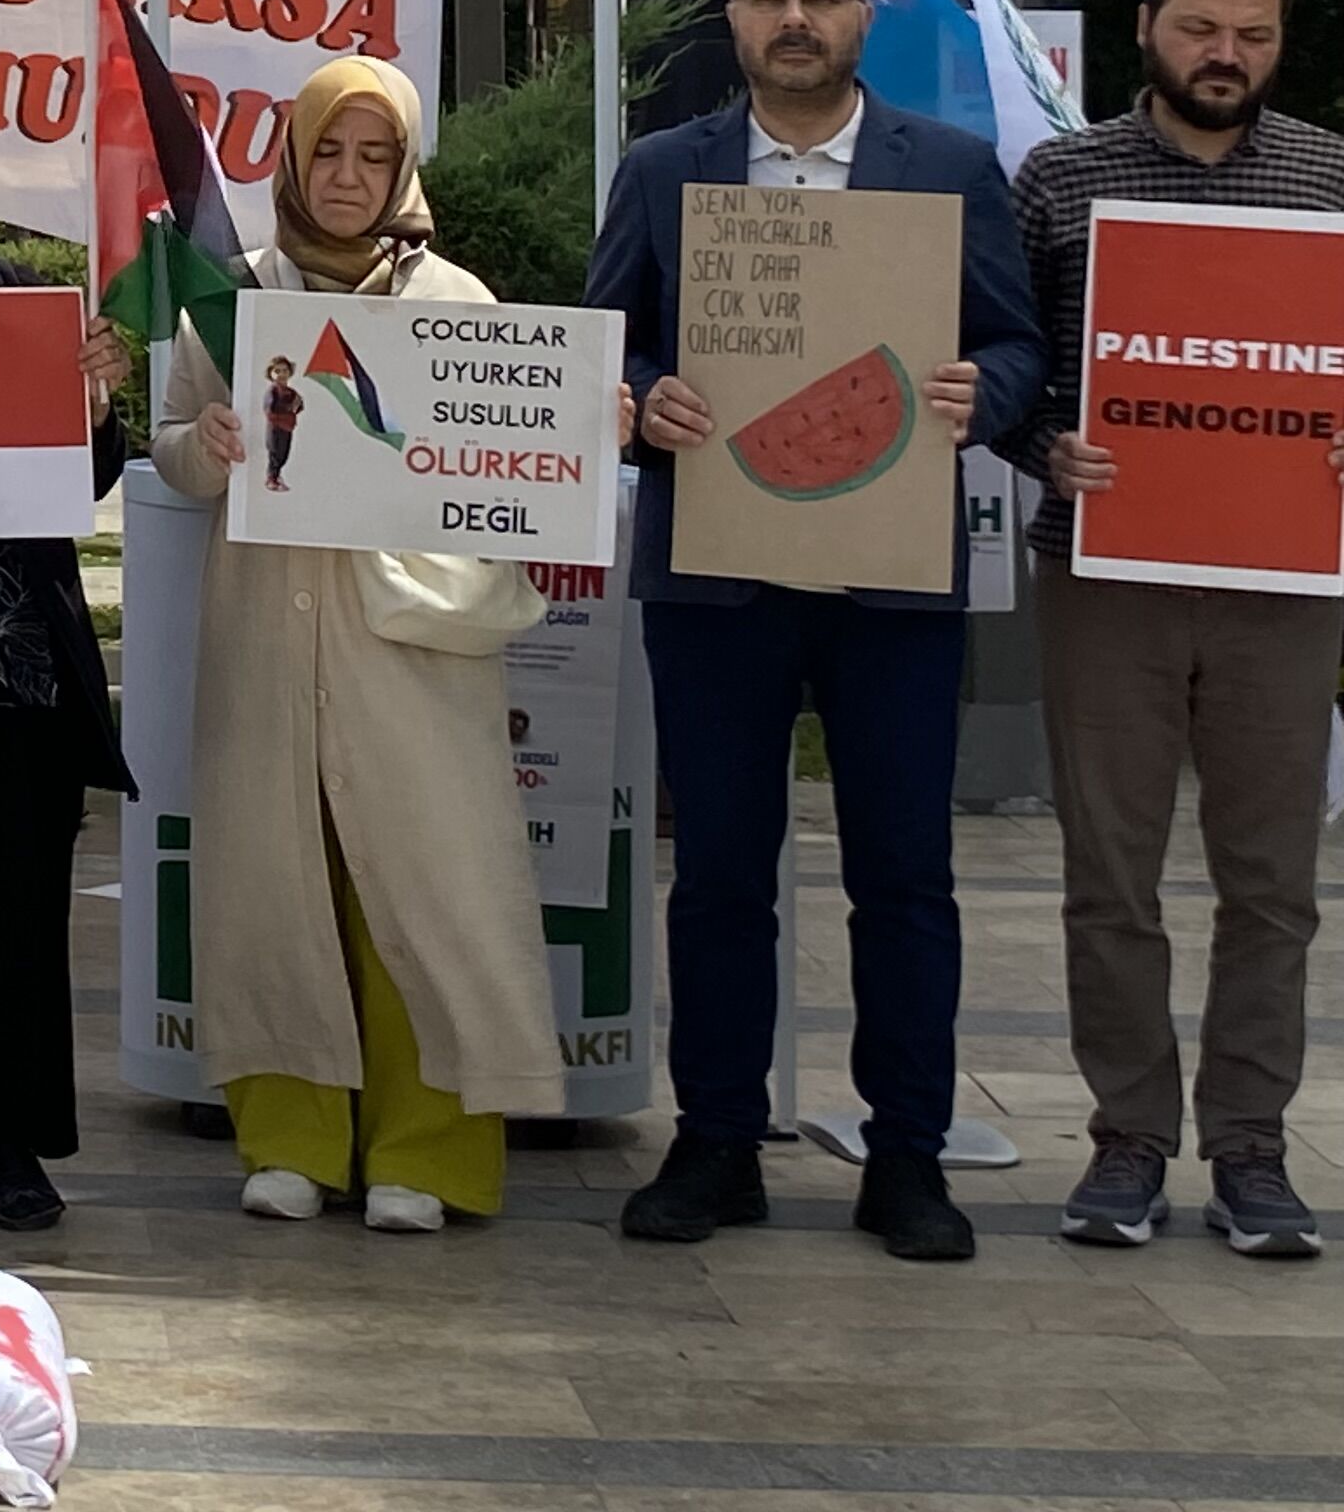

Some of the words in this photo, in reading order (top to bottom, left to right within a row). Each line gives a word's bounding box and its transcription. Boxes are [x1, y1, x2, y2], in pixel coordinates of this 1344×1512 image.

[761, 191, 805, 216] YOK
[689, 249, 733, 282] SEN
[750, 254, 800, 282] DAHA
[758, 292, 801, 322] VAR
[411, 317, 567, 349] ÇOCUKLAR
[1095, 331, 1344, 377] PALESTINE
[431, 359, 562, 389] UYURKEN
[433, 401, 556, 430] SUSULUR
[1100, 397, 1333, 441] GENOCIDE
[405, 435, 582, 484] ÖLÜRKEN
[441, 496, 539, 535] DEĞİL
